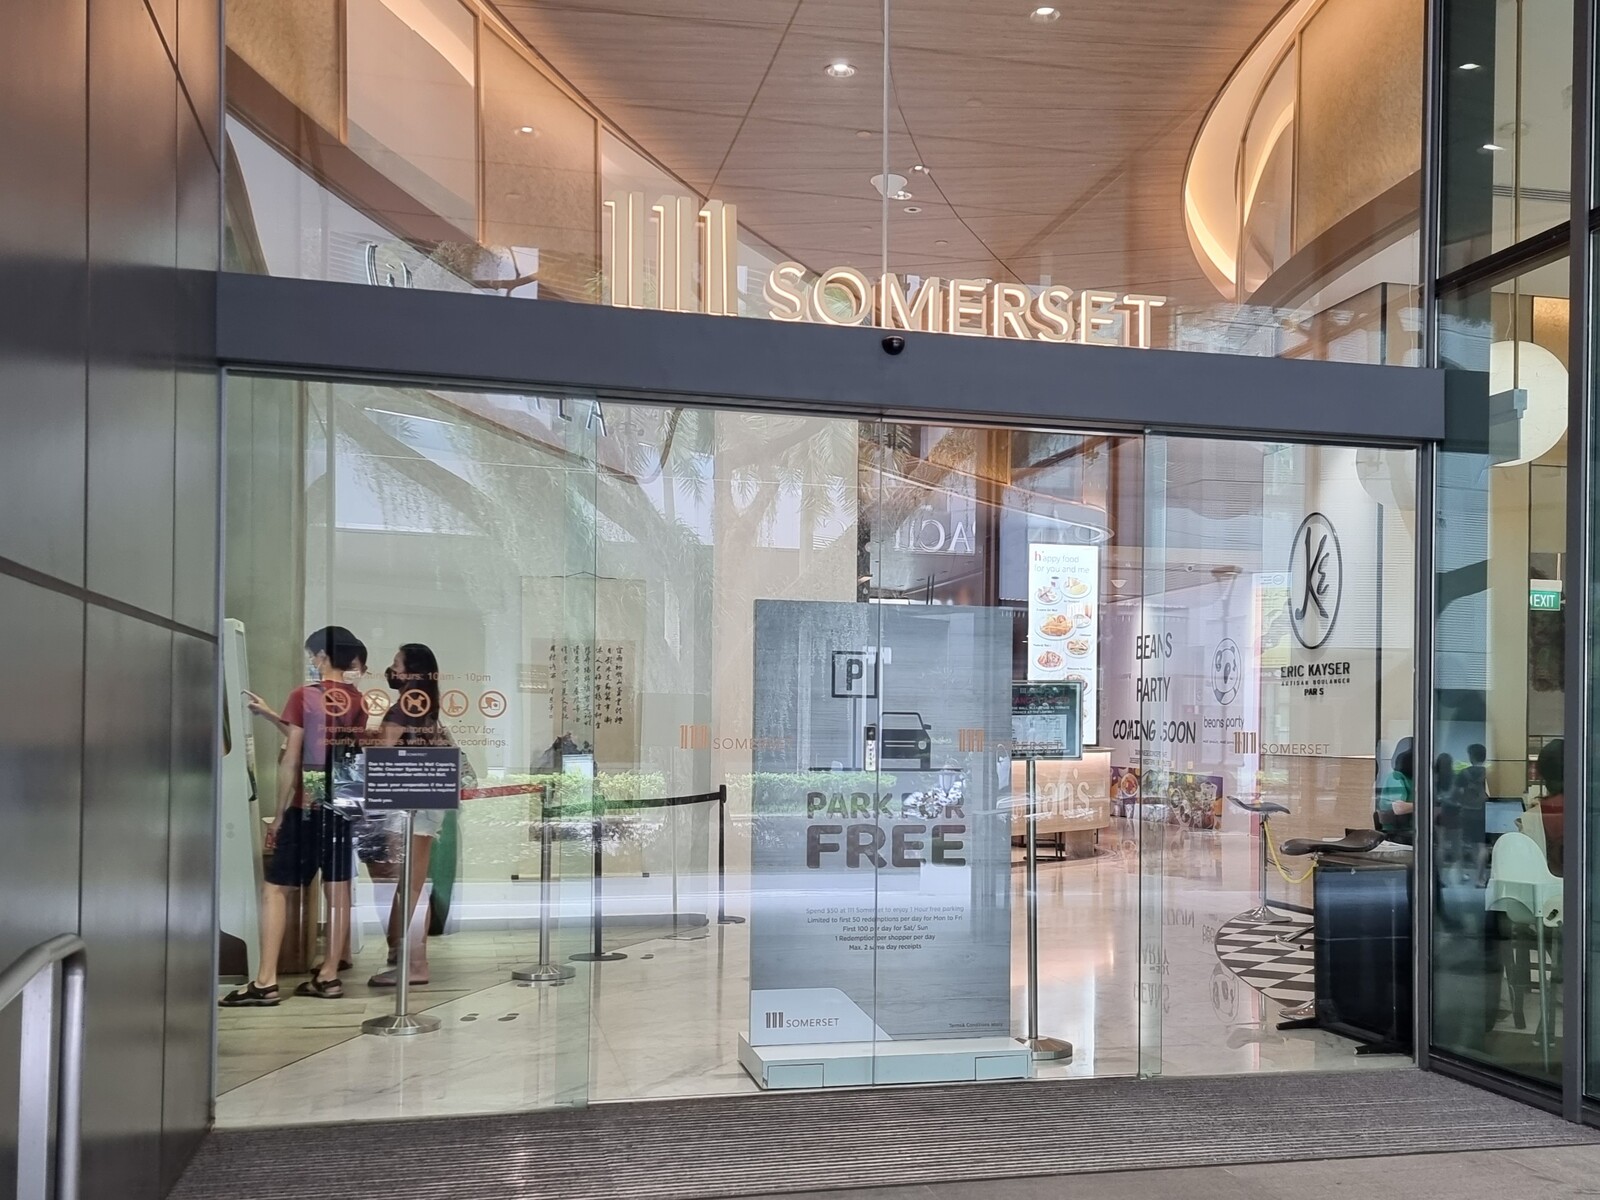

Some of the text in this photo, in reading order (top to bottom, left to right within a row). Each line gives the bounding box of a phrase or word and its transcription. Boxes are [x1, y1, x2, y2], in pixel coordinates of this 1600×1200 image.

[763, 262, 1167, 349] SOMERSET
[1062, 555, 1080, 563] food
[1034, 565, 1044, 573] for
[1046, 566, 1060, 574] you
[1062, 565, 1076, 573] and
[1533, 594, 1556, 607] EXIT
[1135, 632, 1173, 660] BEANS
[846, 658, 864, 691] P
[1281, 661, 1351, 678] ERIC KAYSER
[465, 673, 492, 683] 10pm
[1312, 678, 1351, 686] BOULANGER
[1136, 677, 1171, 702] PARTY
[1304, 687, 1325, 697] PARS
[317, 725, 364, 733] Premises
[451, 725, 480, 734] CCTV
[482, 725, 496, 734] for
[1203, 716, 1245, 731] beans party
[1112, 720, 1197, 744] COMING SOON
[359, 738, 404, 748] purpos
[712, 737, 794, 750] SOMET
[1260, 743, 1331, 755] SOMERSET
[806, 792, 893, 819] PARK
[806, 824, 967, 868] FREE
[856, 906, 884, 914] Someret
[942, 905, 964, 914] parking
[869, 925, 880, 933] pr
[886, 943, 897, 951] day
[786, 1017, 840, 1028] SOMERSET
